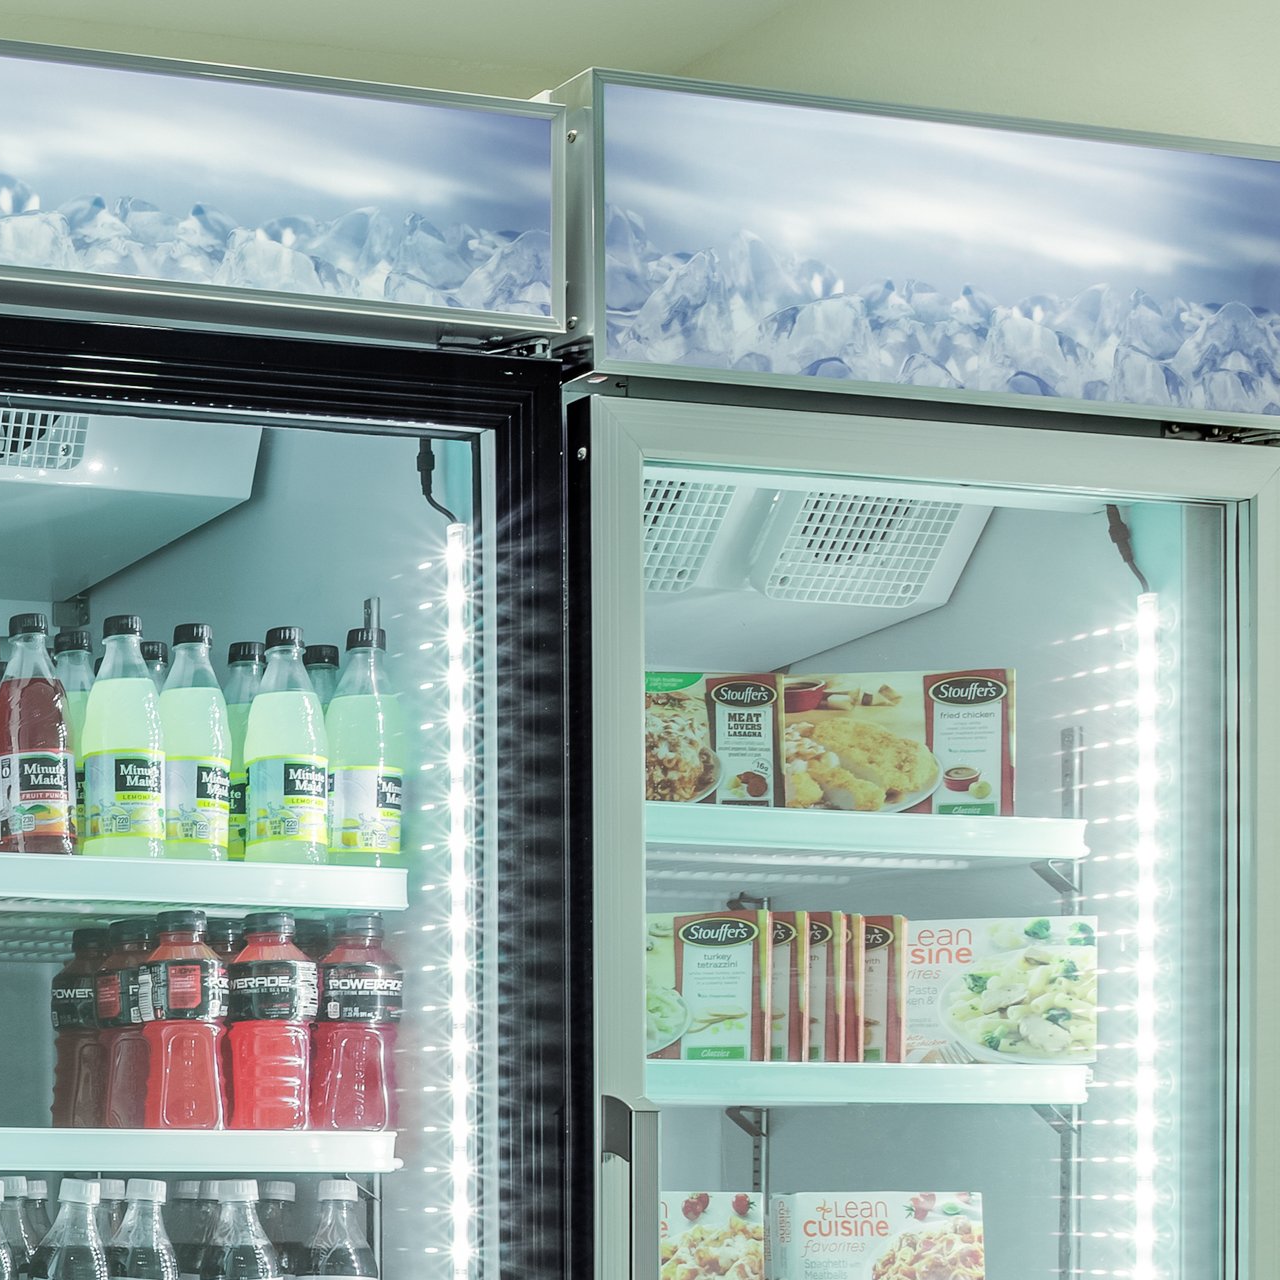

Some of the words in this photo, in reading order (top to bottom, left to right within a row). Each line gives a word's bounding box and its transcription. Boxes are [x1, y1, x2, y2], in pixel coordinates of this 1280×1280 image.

[720, 686, 768, 703] Stouffer's
[939, 682, 996, 701] Stouffer's
[728, 713, 762, 722] MEAT
[940, 712, 960, 720] fried
[962, 711, 995, 719] chicken
[689, 923, 747, 945] Stouffer's
[909, 986, 938, 994] Pasta
[835, 1201, 888, 1219] Lean
[803, 1219, 889, 1237] cuisine
[805, 1259, 848, 1271] Spaghetti
